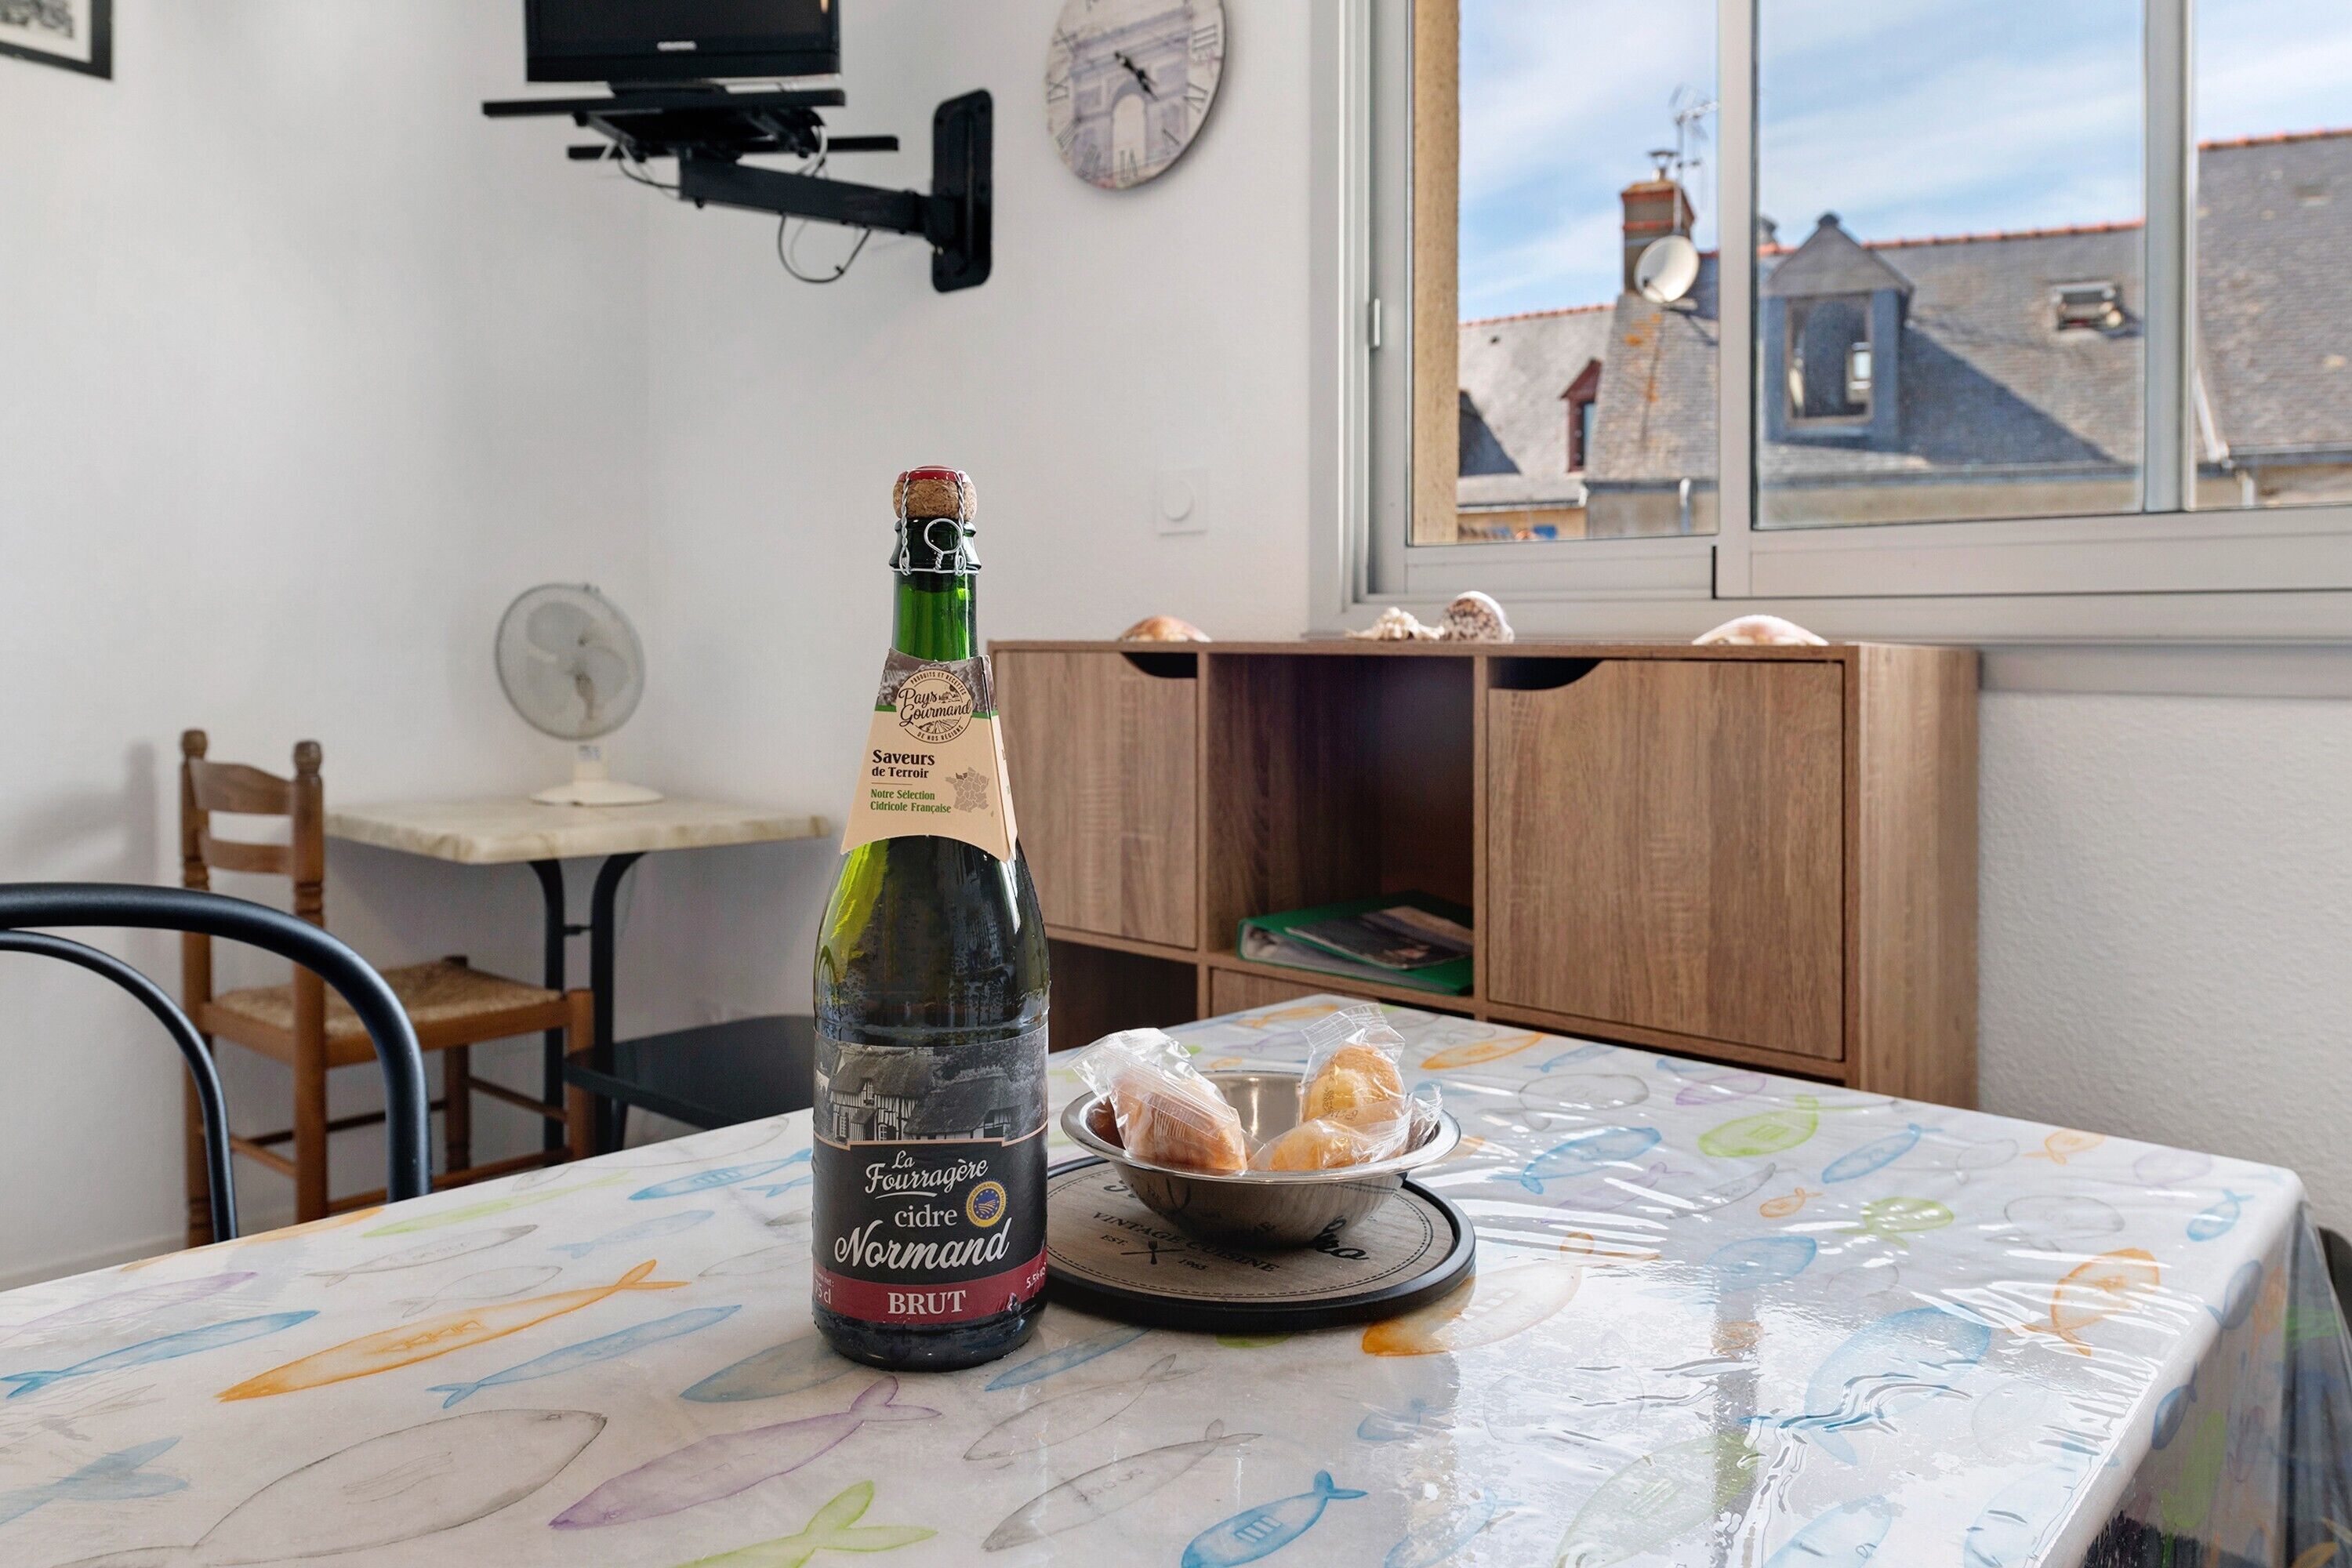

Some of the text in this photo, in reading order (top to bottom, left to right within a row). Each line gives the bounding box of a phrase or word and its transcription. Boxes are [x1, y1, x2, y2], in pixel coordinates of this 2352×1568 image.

[910, 671, 936, 684] PRODUITS
[946, 673, 967, 695] RECETTES
[898, 688, 938, 708] Pays
[898, 699, 971, 728] Gourmand
[872, 749, 935, 766] Saveurs
[872, 767, 929, 779] de Terroir
[870, 789, 935, 800] Notre Sélection
[870, 800, 952, 814] Cidricole Française
[891, 1149, 916, 1169] La
[864, 1158, 989, 1194] Fourragère
[894, 1203, 958, 1228] cidre
[834, 1217, 1013, 1270] Normand
[1093, 1211, 1186, 1243] VINTAGE
[1186, 1241, 1280, 1272] CUISINE
[1100, 1234, 1129, 1247] EST.
[1178, 1258, 1210, 1271] 1965
[824, 1288, 831, 1305] cl
[887, 1290, 967, 1316] BRUT
